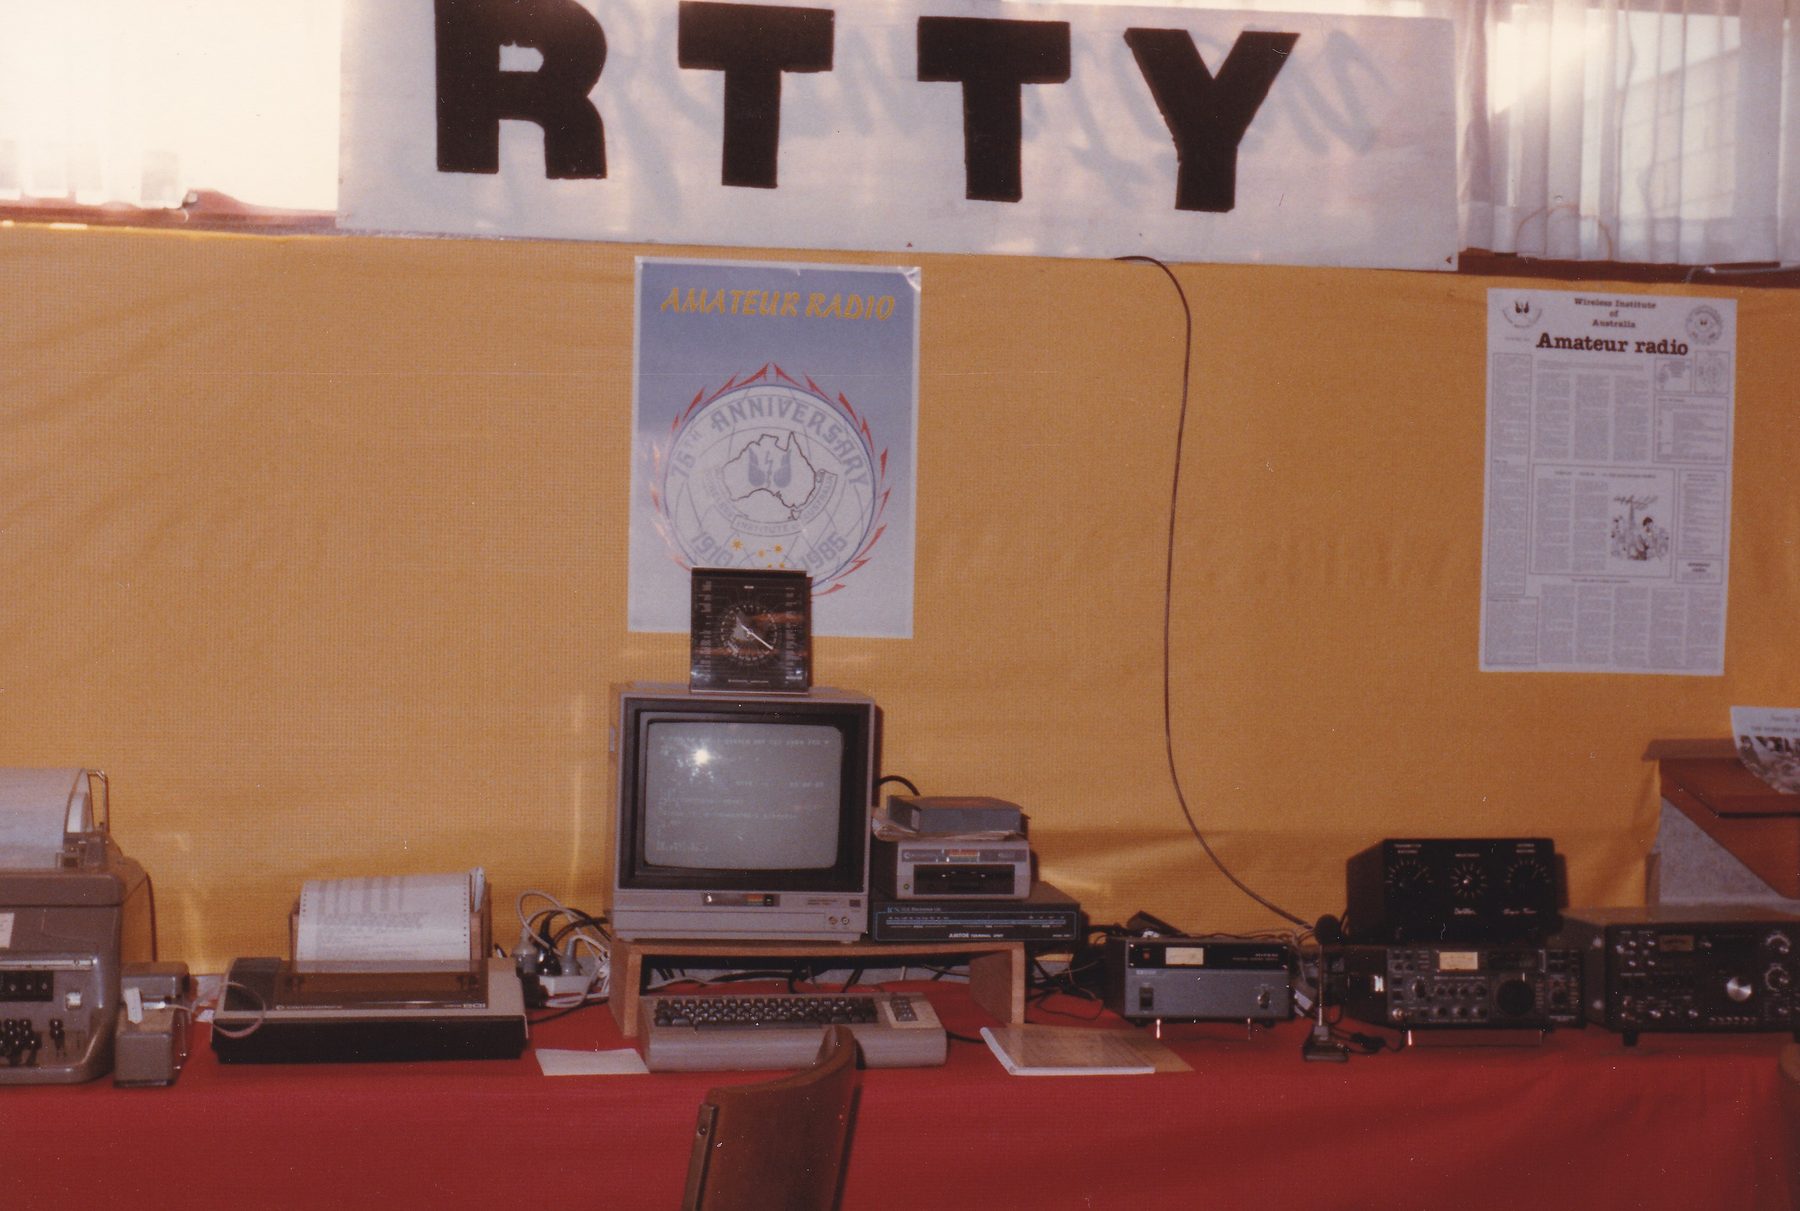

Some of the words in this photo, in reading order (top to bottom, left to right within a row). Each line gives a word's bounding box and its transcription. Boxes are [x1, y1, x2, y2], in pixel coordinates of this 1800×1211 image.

[435, 0, 1301, 213] RTTY
[660, 287, 799, 317] AMATEUR
[805, 292, 896, 321] RADIO
[1574, 298, 1613, 307] Wireless
[1615, 300, 1657, 309] Institute
[1609, 310, 1619, 318] of
[1592, 319, 1636, 328] Australia
[1535, 332, 1629, 353] Amateur
[1634, 339, 1689, 356] radio
[711, 397, 870, 487] ANNIVERSARY
[800, 531, 849, 571] 1985
